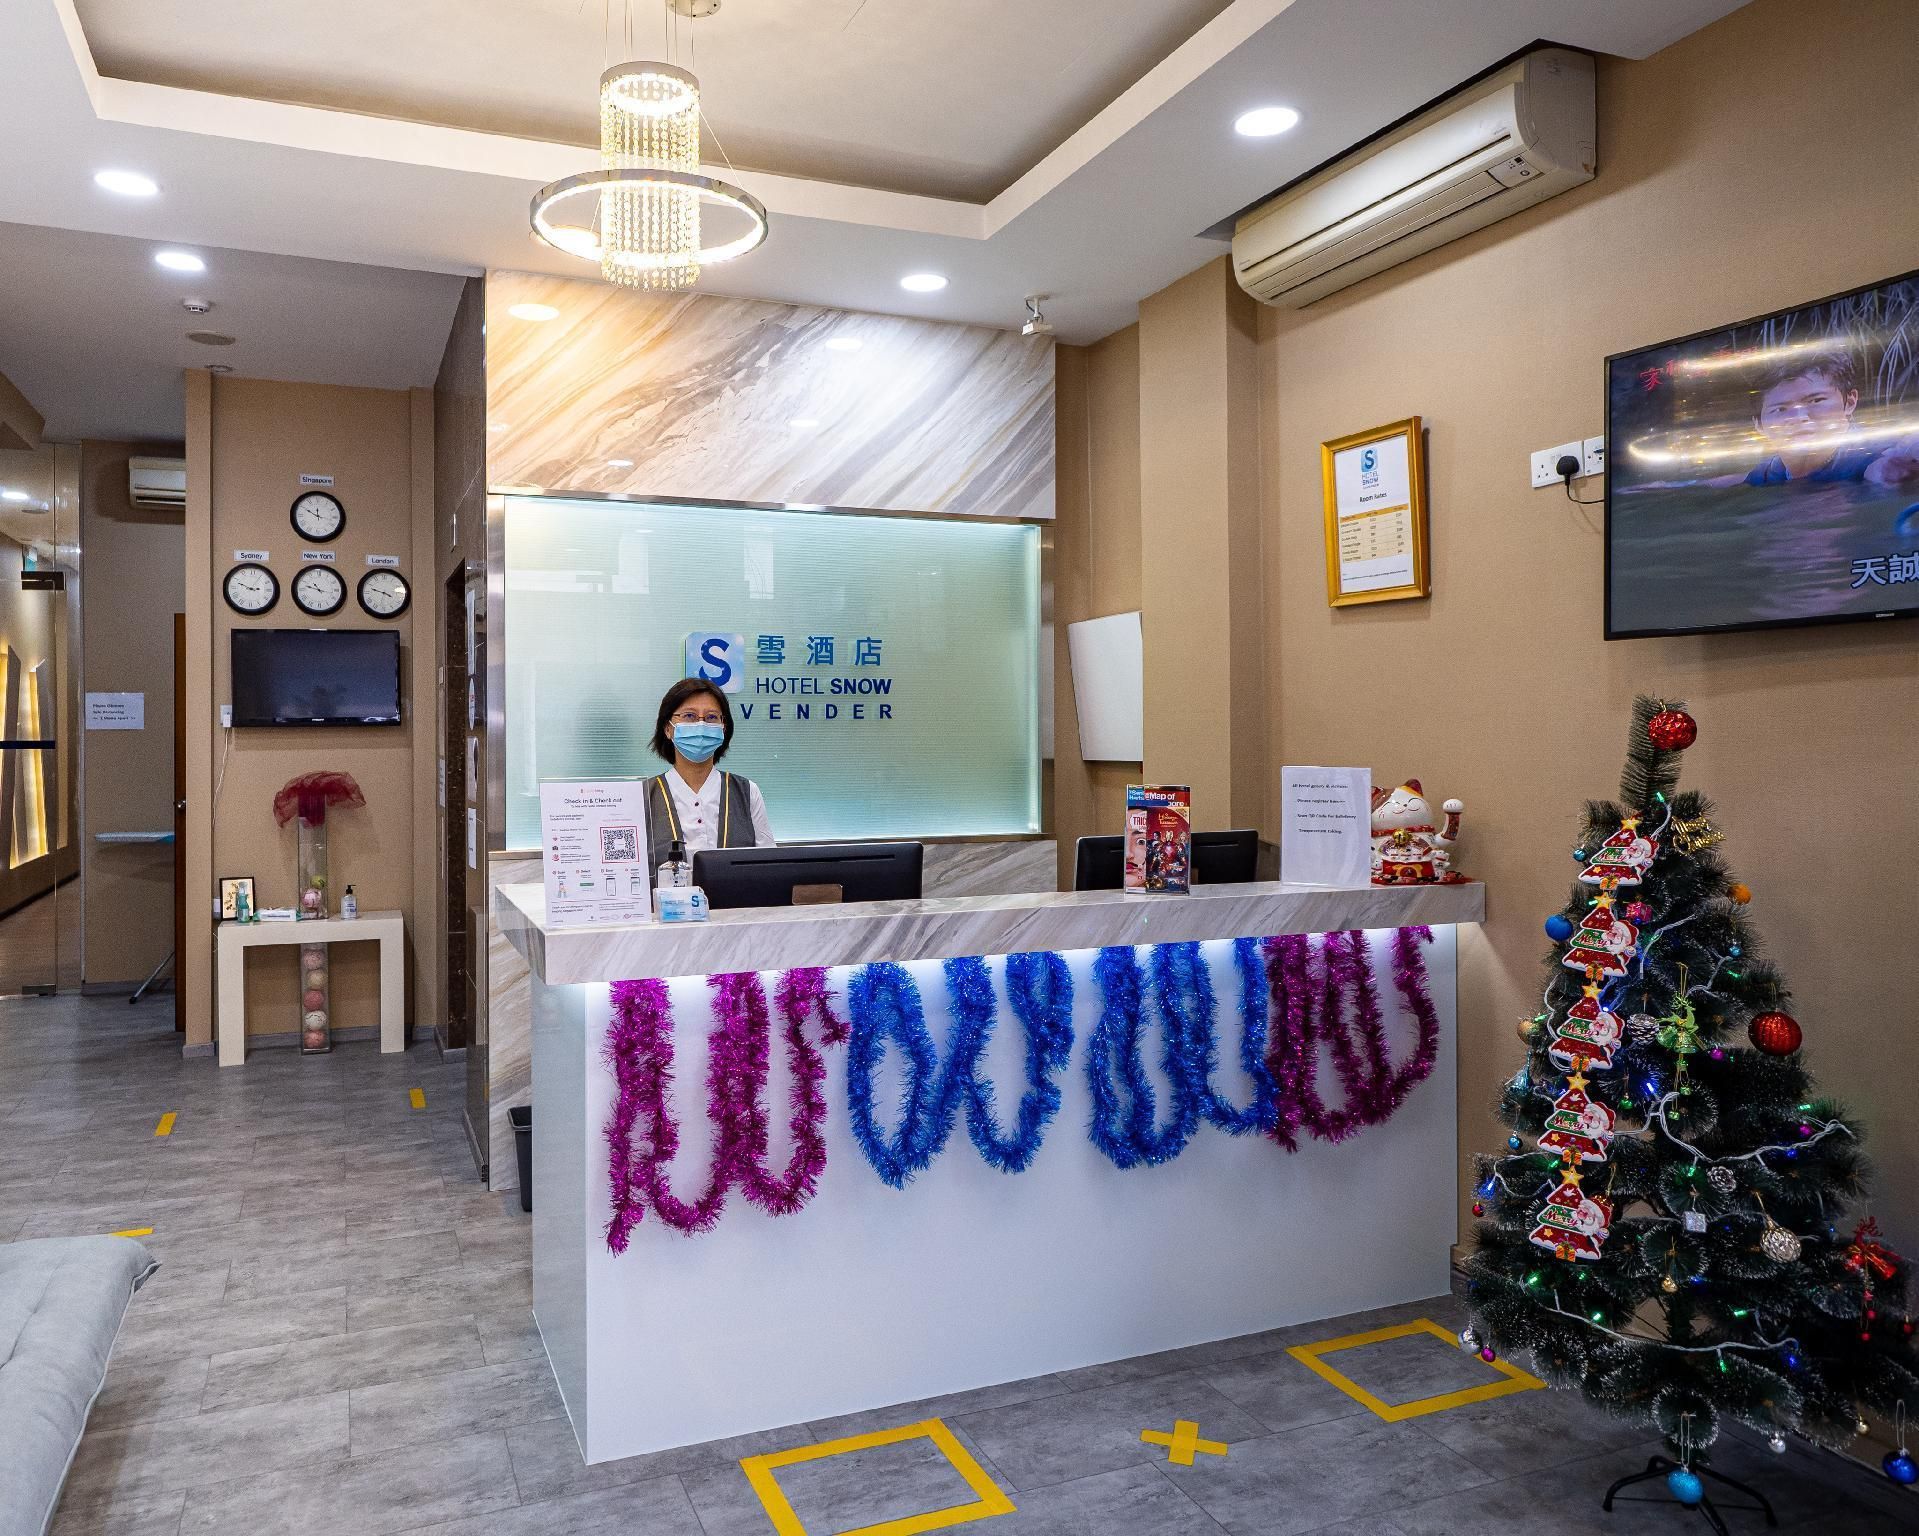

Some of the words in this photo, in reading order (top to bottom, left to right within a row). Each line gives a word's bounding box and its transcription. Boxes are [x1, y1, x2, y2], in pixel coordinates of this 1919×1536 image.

[240, 552, 263, 560] Sydney
[756, 634, 883, 666] 雪酒店
[756, 677, 825, 695] HOTEL
[830, 677, 892, 695] SNOW
[1149, 792, 1167, 800] Map
[1167, 792, 1176, 800] of
